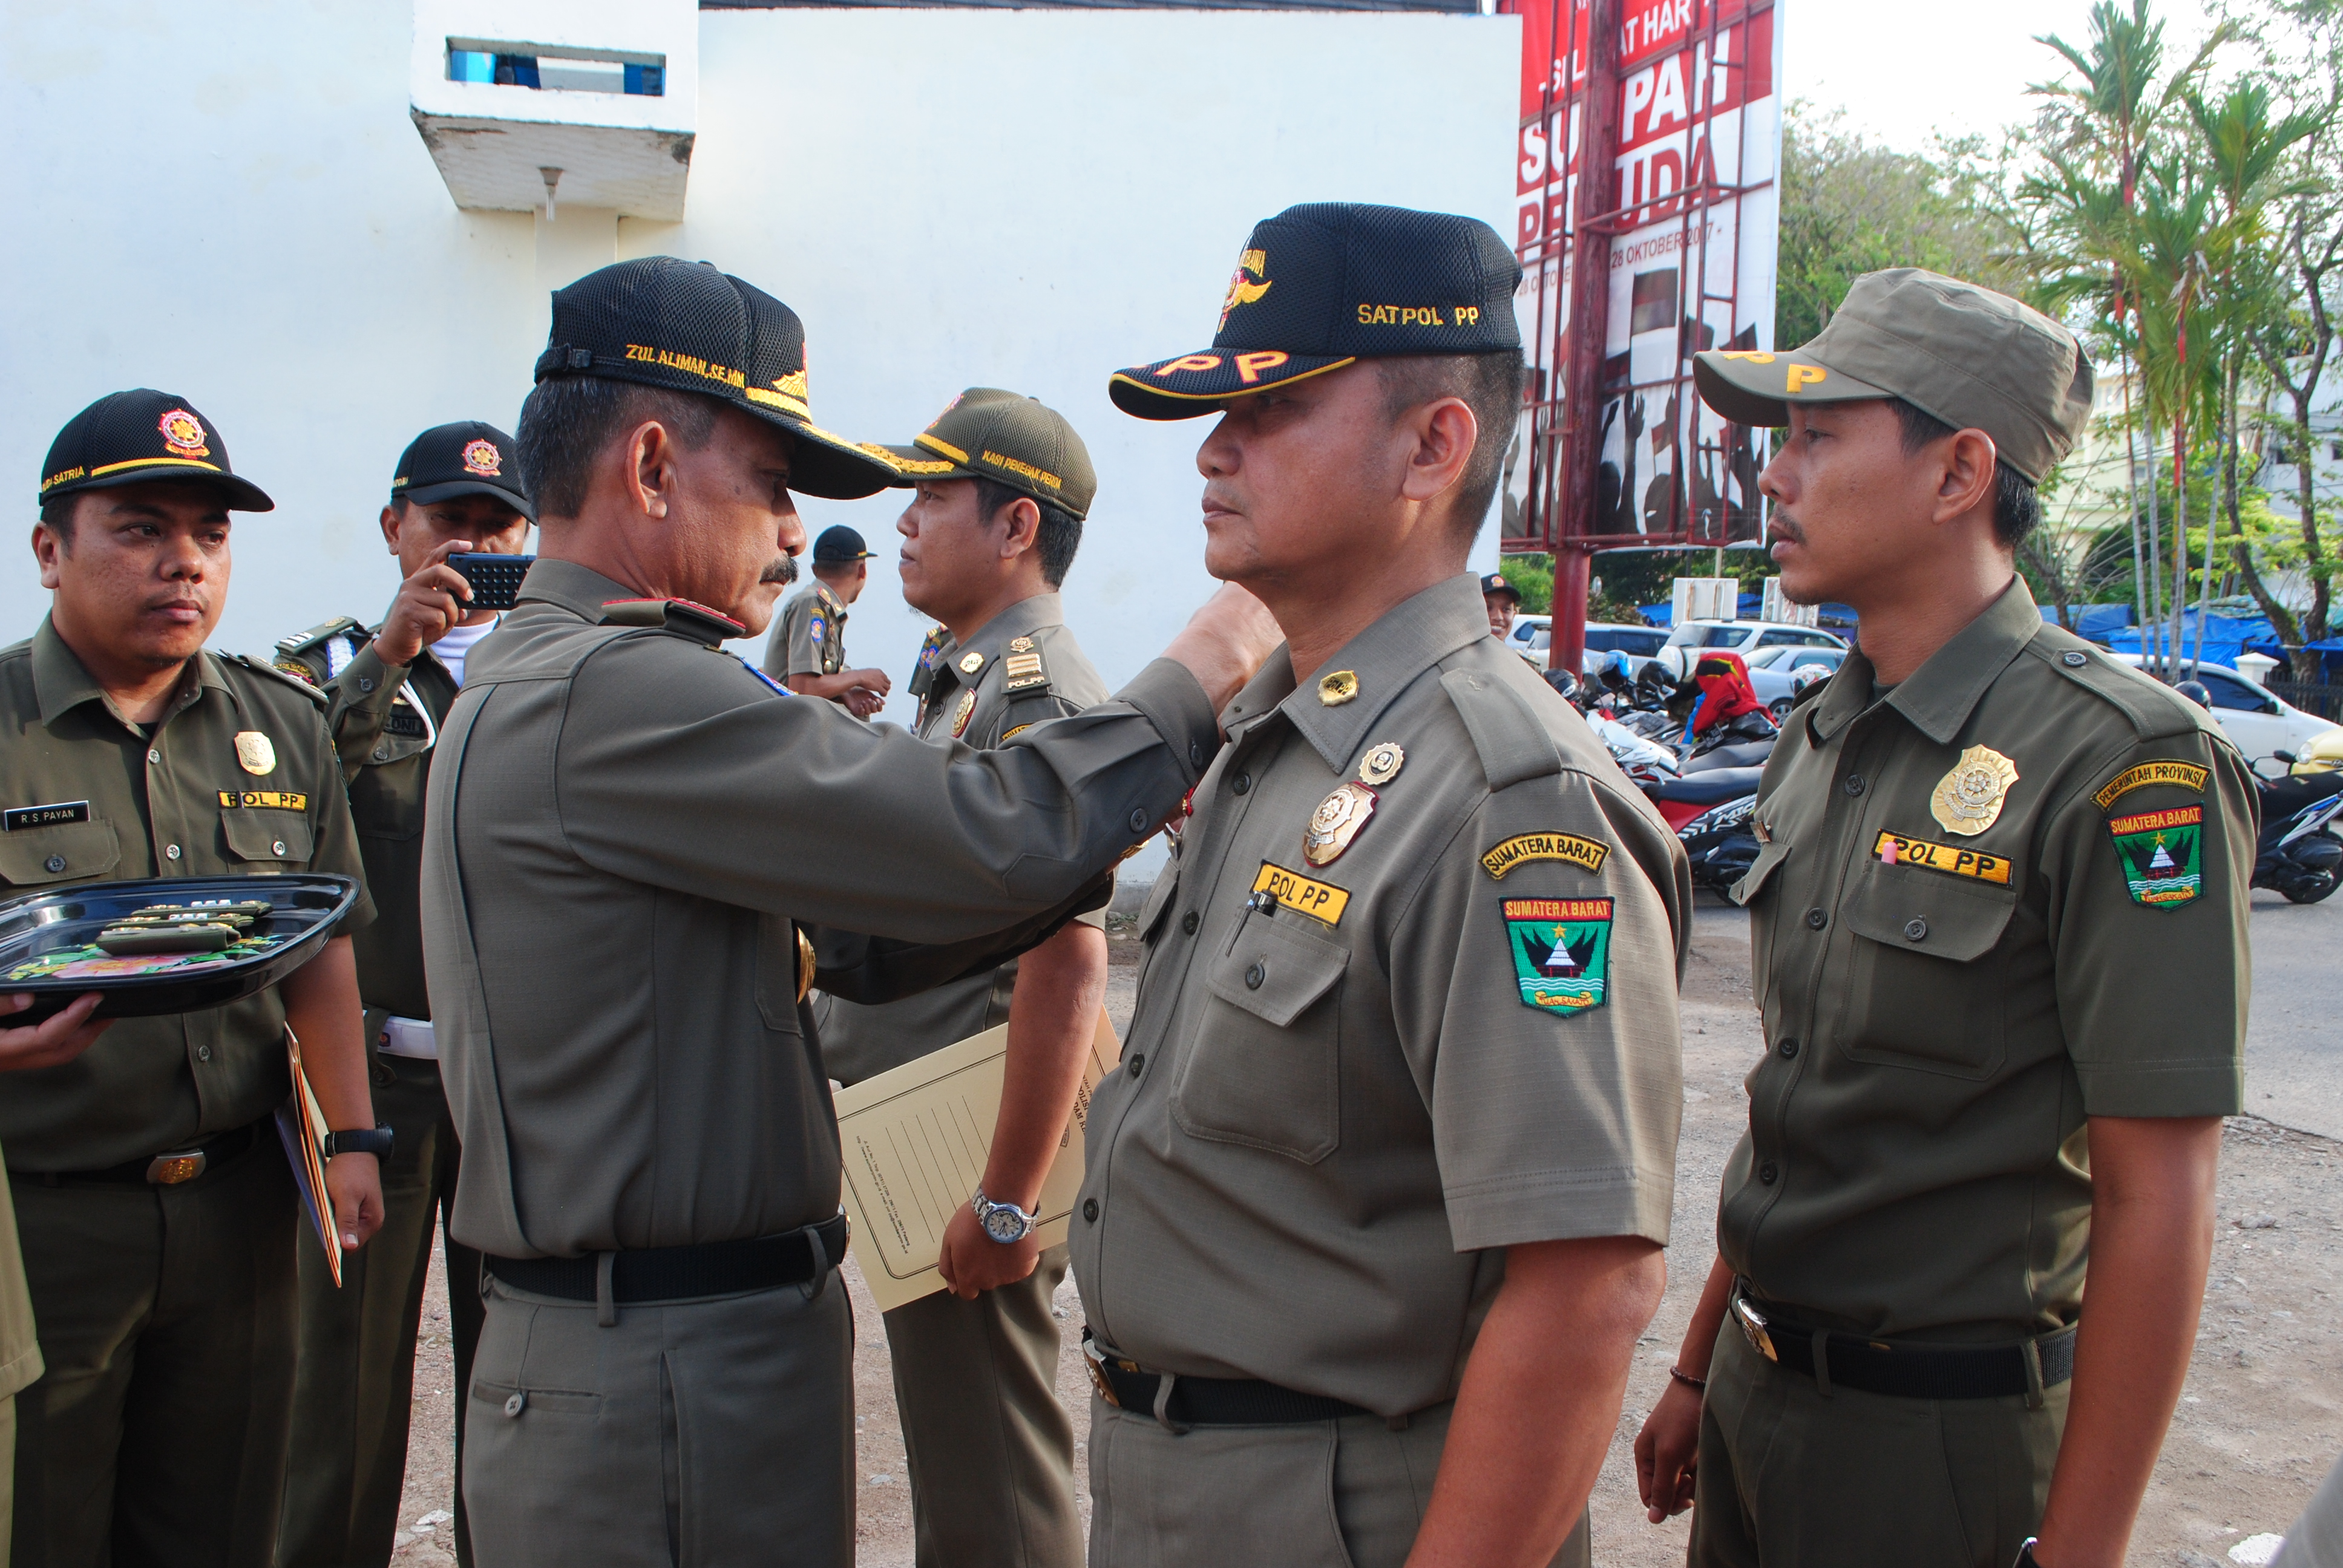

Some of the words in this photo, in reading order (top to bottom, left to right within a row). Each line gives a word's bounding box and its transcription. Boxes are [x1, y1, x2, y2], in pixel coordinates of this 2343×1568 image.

[1611, 250, 1624, 270] 28
[1626, 232, 1683, 264] OKTOBER
[1686, 221, 1714, 247] 207
[1357, 304, 1444, 326] SATPOL
[1454, 306, 1479, 326] PP
[625, 344, 655, 362] ZUL
[53, 465, 85, 485] SATRIA
[981, 449, 1004, 466] KASI
[1003, 457, 1041, 480] PENEGAK
[2098, 766, 2152, 804] PEMERINTAH
[2154, 765, 2203, 786] PROVINSI
[279, 793, 298, 808] PP
[44, 809, 74, 821] PAYAN
[2110, 814, 2165, 833] SUMATERA
[2166, 807, 2201, 825] BARAT
[1486, 837, 1555, 871] SUMATERA
[1556, 838, 1602, 865] BARAT
[1954, 851, 1996, 876] PP
[1267, 872, 1296, 902] POL
[1299, 885, 1330, 910] PP
[1505, 901, 1568, 916] SUMATERA
[1570, 901, 1609, 917] BARAT
